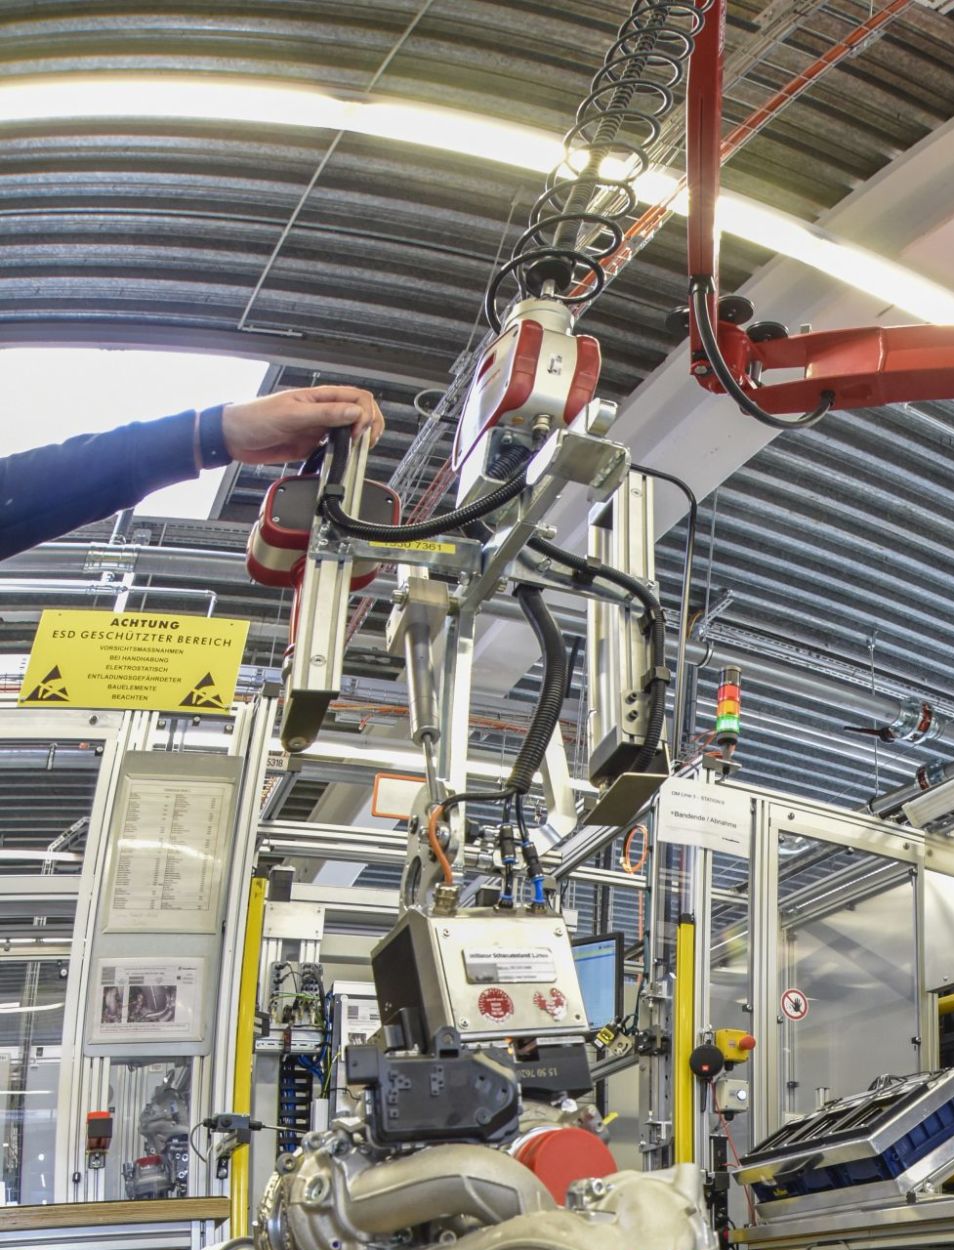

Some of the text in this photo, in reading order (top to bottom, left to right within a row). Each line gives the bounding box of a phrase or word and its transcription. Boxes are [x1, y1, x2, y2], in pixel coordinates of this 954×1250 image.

[110, 617, 180, 630] ACHTUNG
[52, 630, 232, 647] ESD GESCHÜTZTER BEREICH
[100, 645, 184, 655] VORSICHTSMASSNAHMEN
[122, 655, 169, 663] HANDHABUNG
[105, 664, 168, 673] ELEKTROSTATISCH
[111, 693, 148, 701] BEACHTEN
